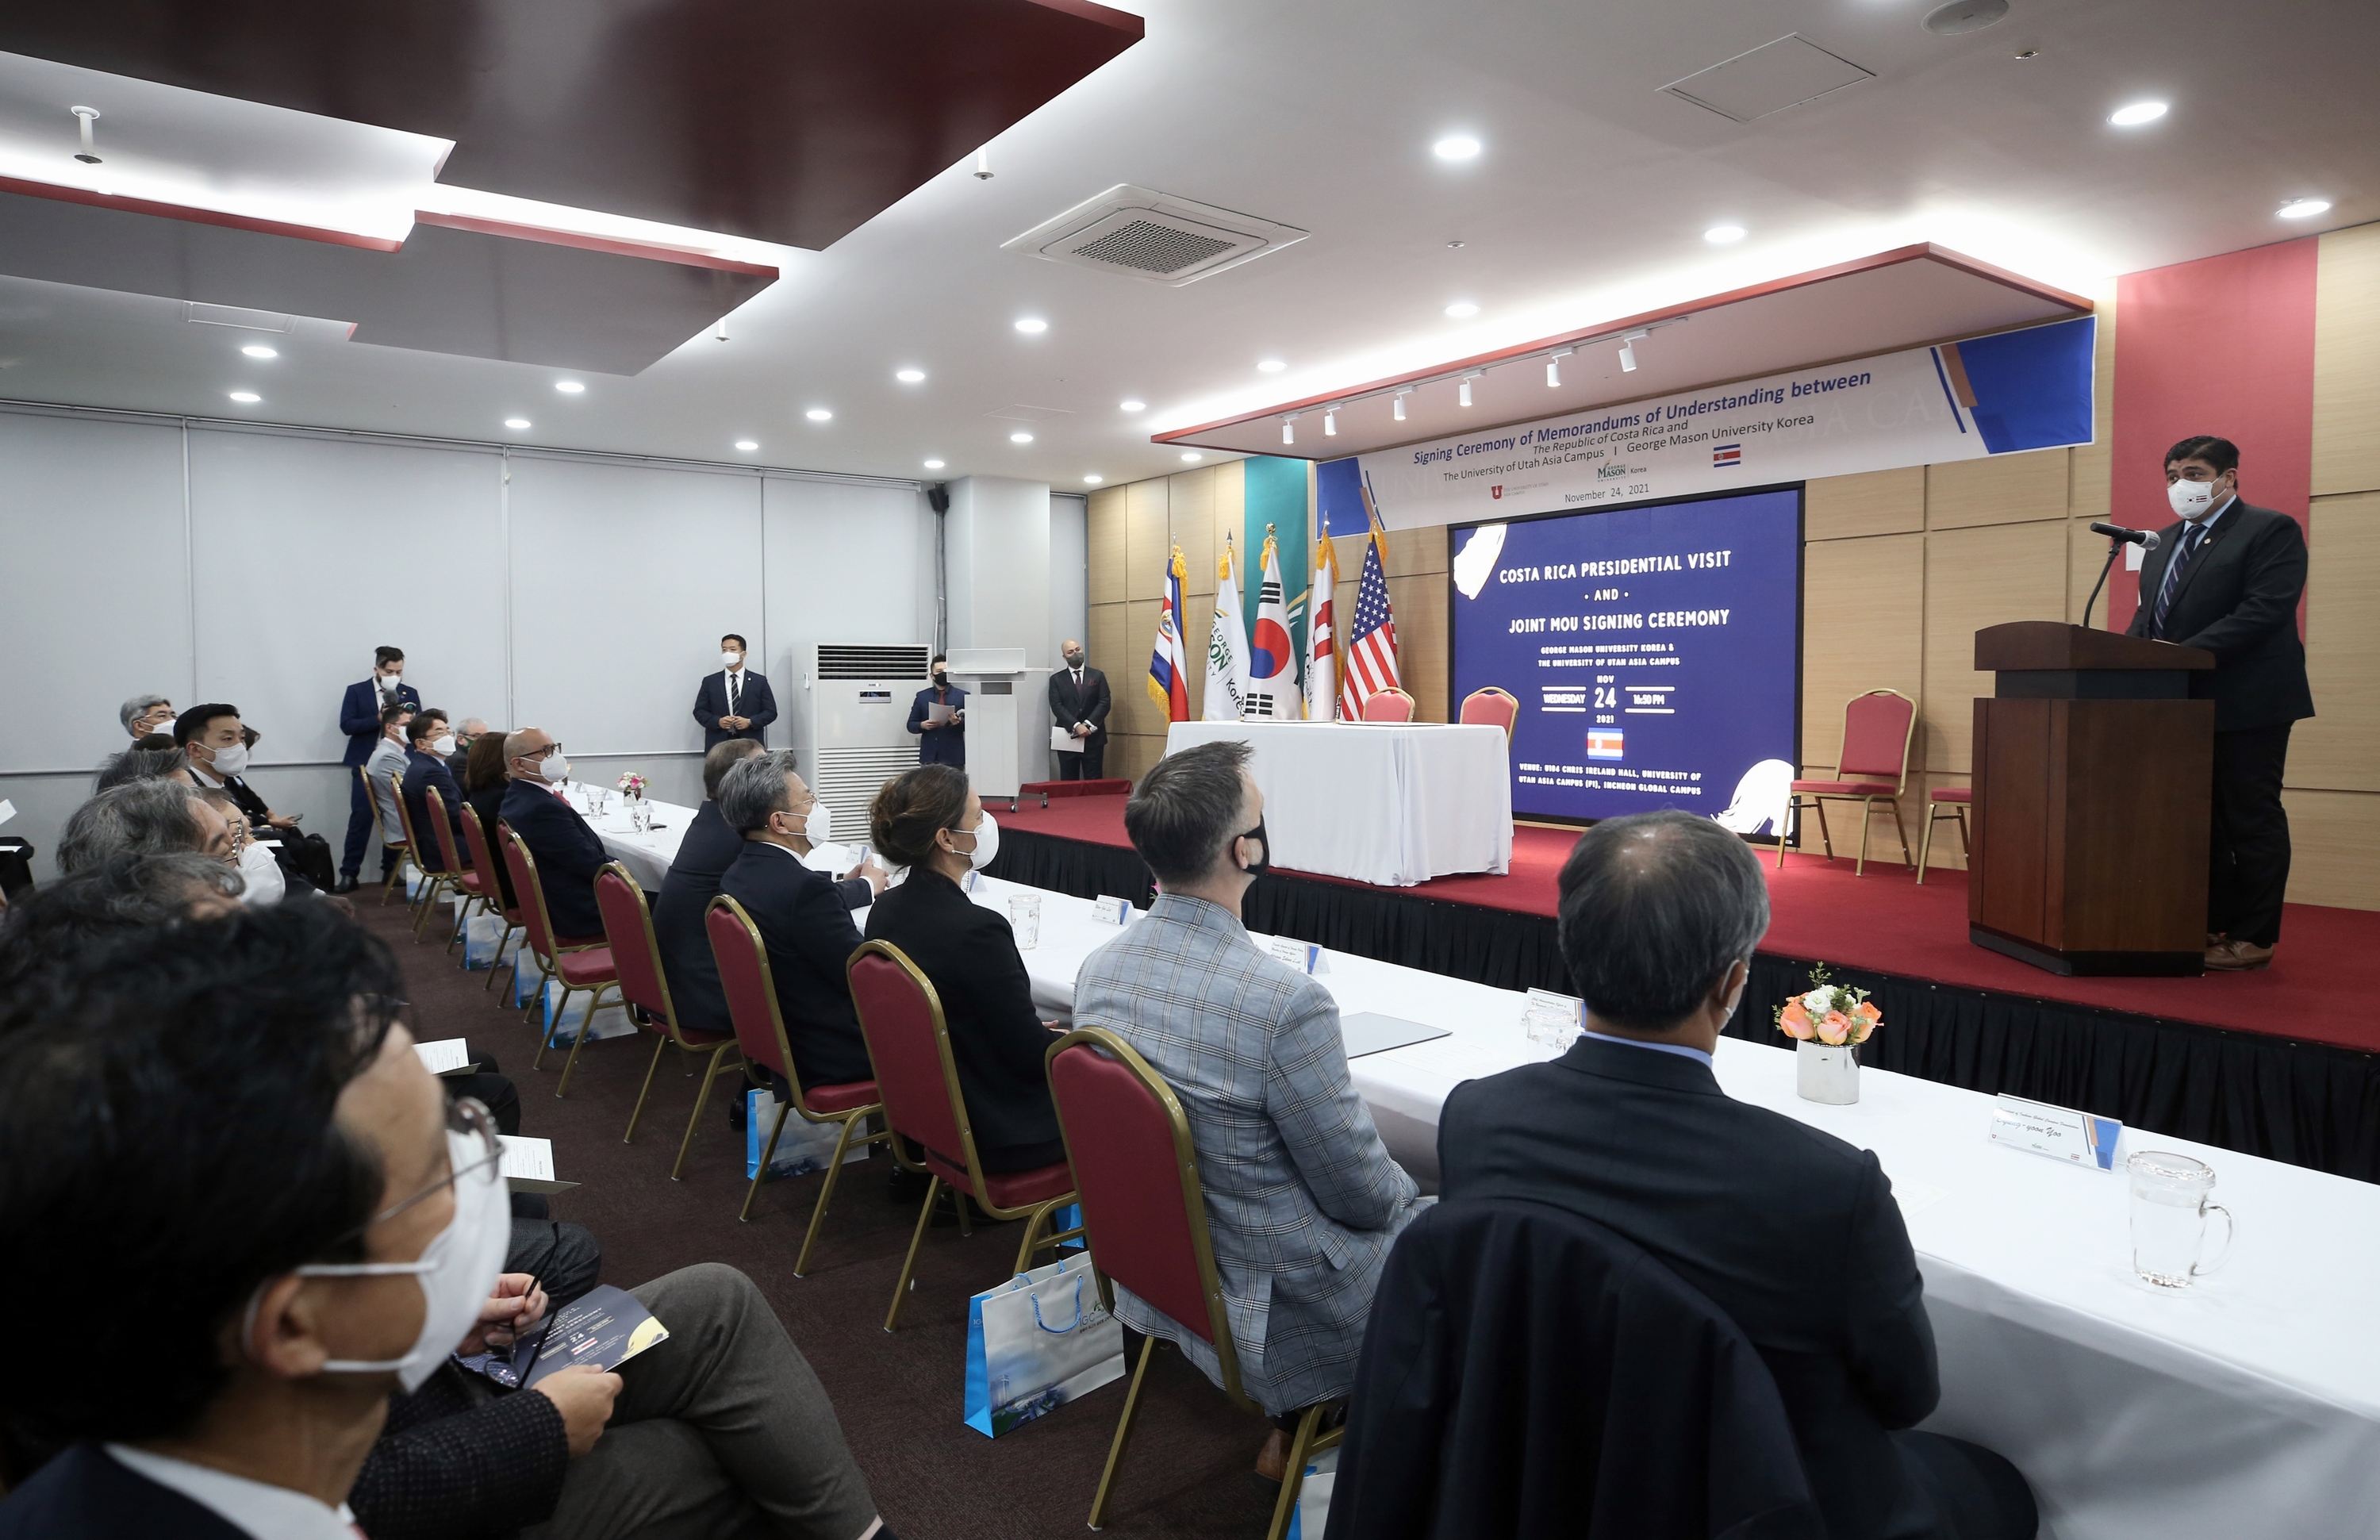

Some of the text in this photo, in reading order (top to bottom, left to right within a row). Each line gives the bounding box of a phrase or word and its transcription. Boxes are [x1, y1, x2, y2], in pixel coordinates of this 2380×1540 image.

[1414, 372, 1871, 465] Signing Ceremony of Memorandums of Understanding between
[1534, 420, 1688, 455] The Republic of Costa Rica and
[1627, 415, 1814, 452] George Mason University Korea
[1444, 472, 1459, 482] The
[1461, 465, 1504, 479] University
[1507, 461, 1516, 471] of
[1518, 458, 1540, 470] Utah
[1542, 455, 1562, 467] Asia
[1564, 449, 1605, 463] Campus
[1598, 467, 1626, 478] MASON
[1491, 485, 1503, 500] U
[1564, 483, 1649, 503] November 24, 2021
[1499, 550, 1731, 584] COSTA RICA PRESIDENTIAL VISIT
[1594, 588, 1618, 601] AND
[1509, 609, 1729, 634] JOINT MOU SIGNING CEREMONY
[1541, 643, 1675, 655] GEORGE MASON UNIVERSITY KOREA &
[1553, 659, 1593, 667] UNIVERSITY
[1628, 658, 1647, 666] ASIA
[1649, 657, 1680, 666] CAMPUS
[1596, 674, 1614, 684] NOV
[1543, 693, 1586, 705] WEDNESDAY
[1594, 686, 1617, 709] 24
[1653, 694, 1665, 705] PM
[1596, 714, 1614, 724] 2021
[1518, 762, 1702, 782] VENUE: U104 CHRIS IRELAND HALL, UNIVERSITY OF
[1518, 775, 1536, 784] UTAH
[1556, 778, 1583, 787] CAMPUS
[1603, 781, 1637, 791] INCHEON
[1638, 783, 1668, 793] GLOBAL
[1670, 785, 1702, 795] CAMPUS
[1079, 1311, 1096, 1327] IGC
[570, 1333, 585, 1343] 24
